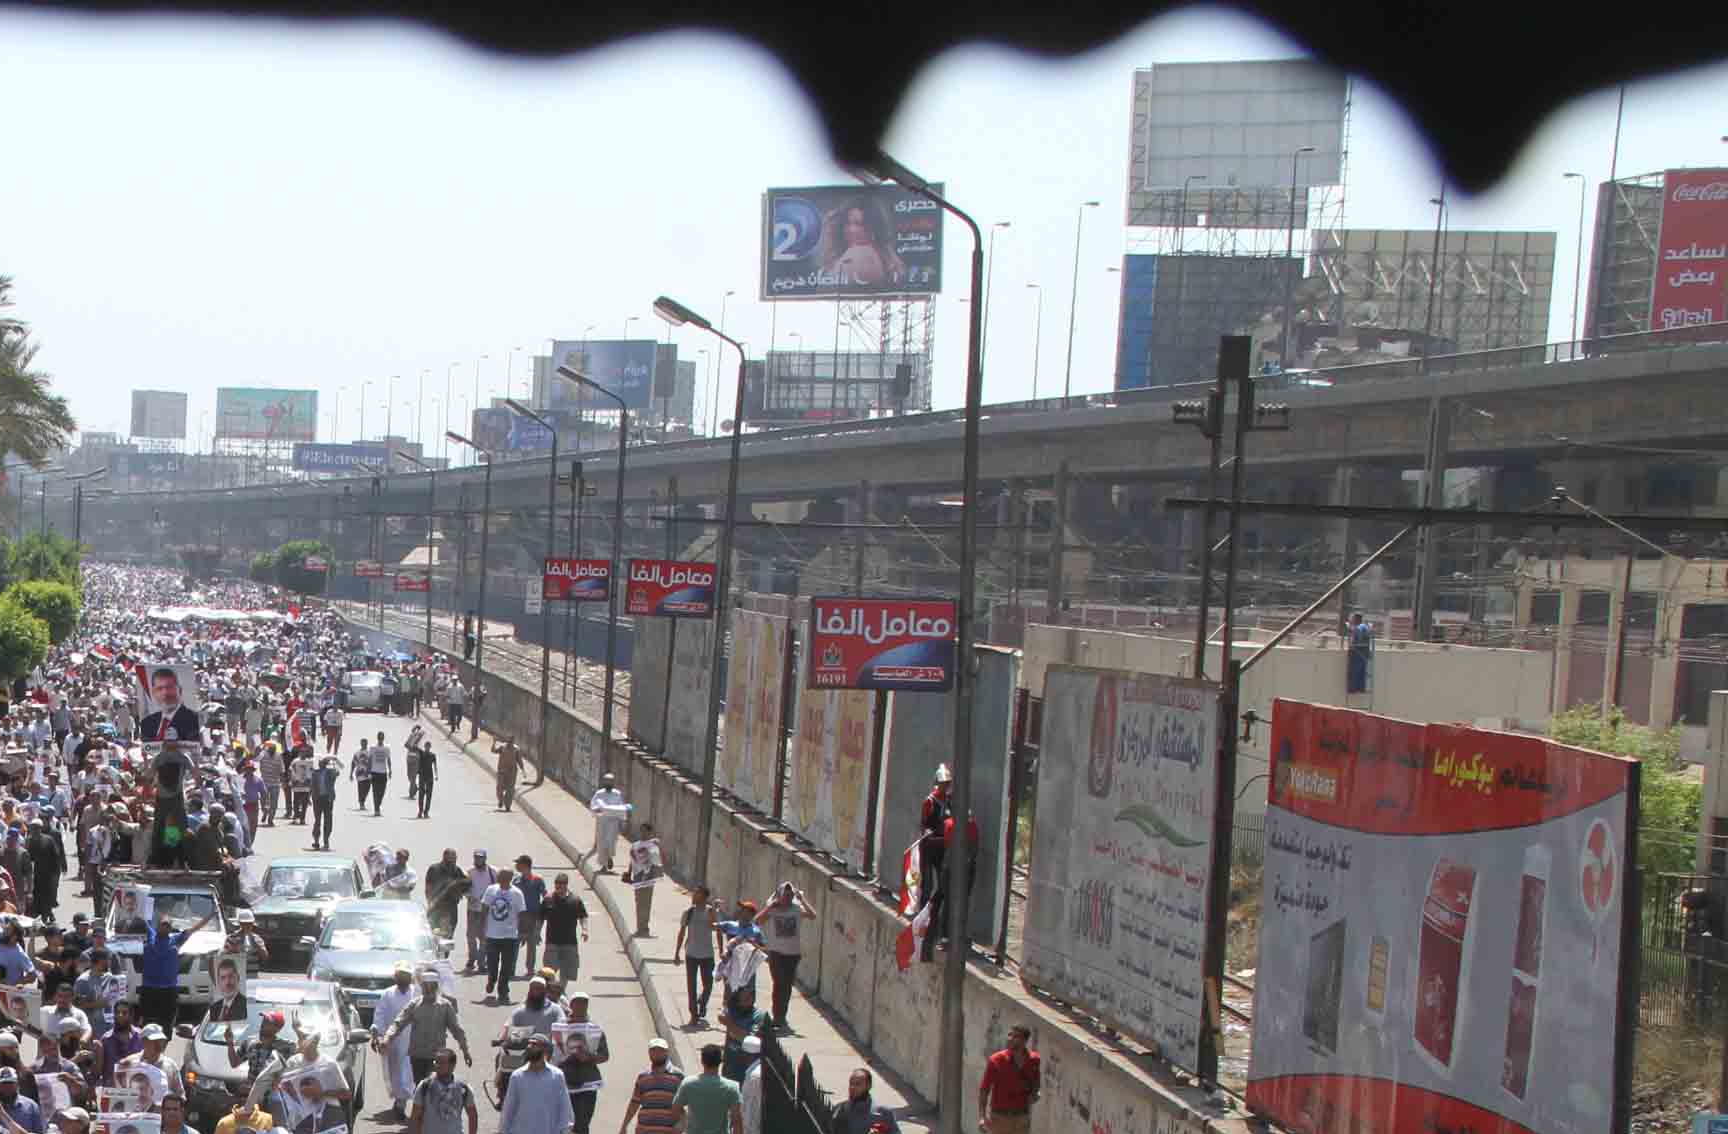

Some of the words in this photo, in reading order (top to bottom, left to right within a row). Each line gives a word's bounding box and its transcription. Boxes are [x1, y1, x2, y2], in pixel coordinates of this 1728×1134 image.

[631, 563, 660, 584] الفا
[660, 567, 712, 588] معامل
[816, 607, 864, 636] الفا
[864, 608, 951, 644] معامل
